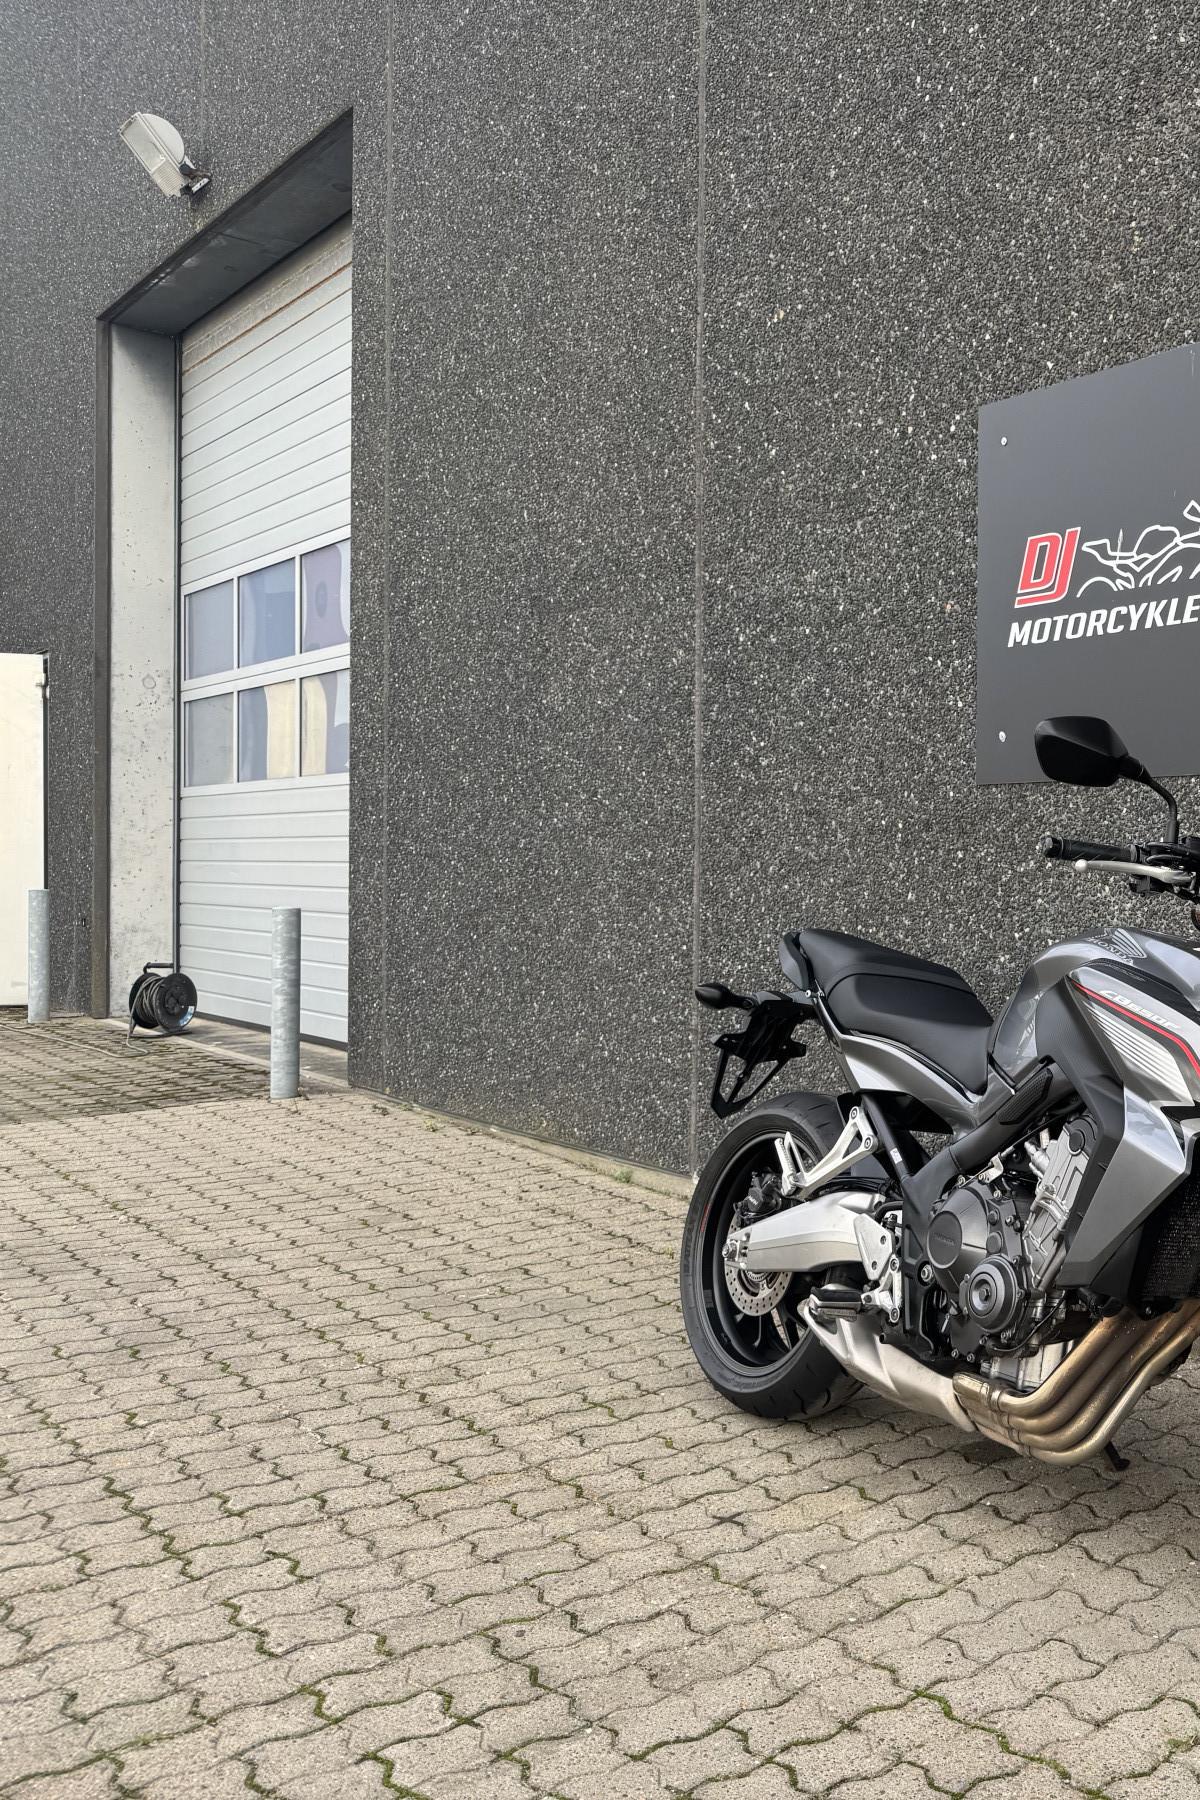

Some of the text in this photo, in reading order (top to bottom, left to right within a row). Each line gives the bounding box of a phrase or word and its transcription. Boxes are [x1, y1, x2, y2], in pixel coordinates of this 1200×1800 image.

[1013, 526, 1082, 609] DJ
[1087, 937, 1135, 966] HONDA
[1099, 990, 1181, 1031] CB650F
